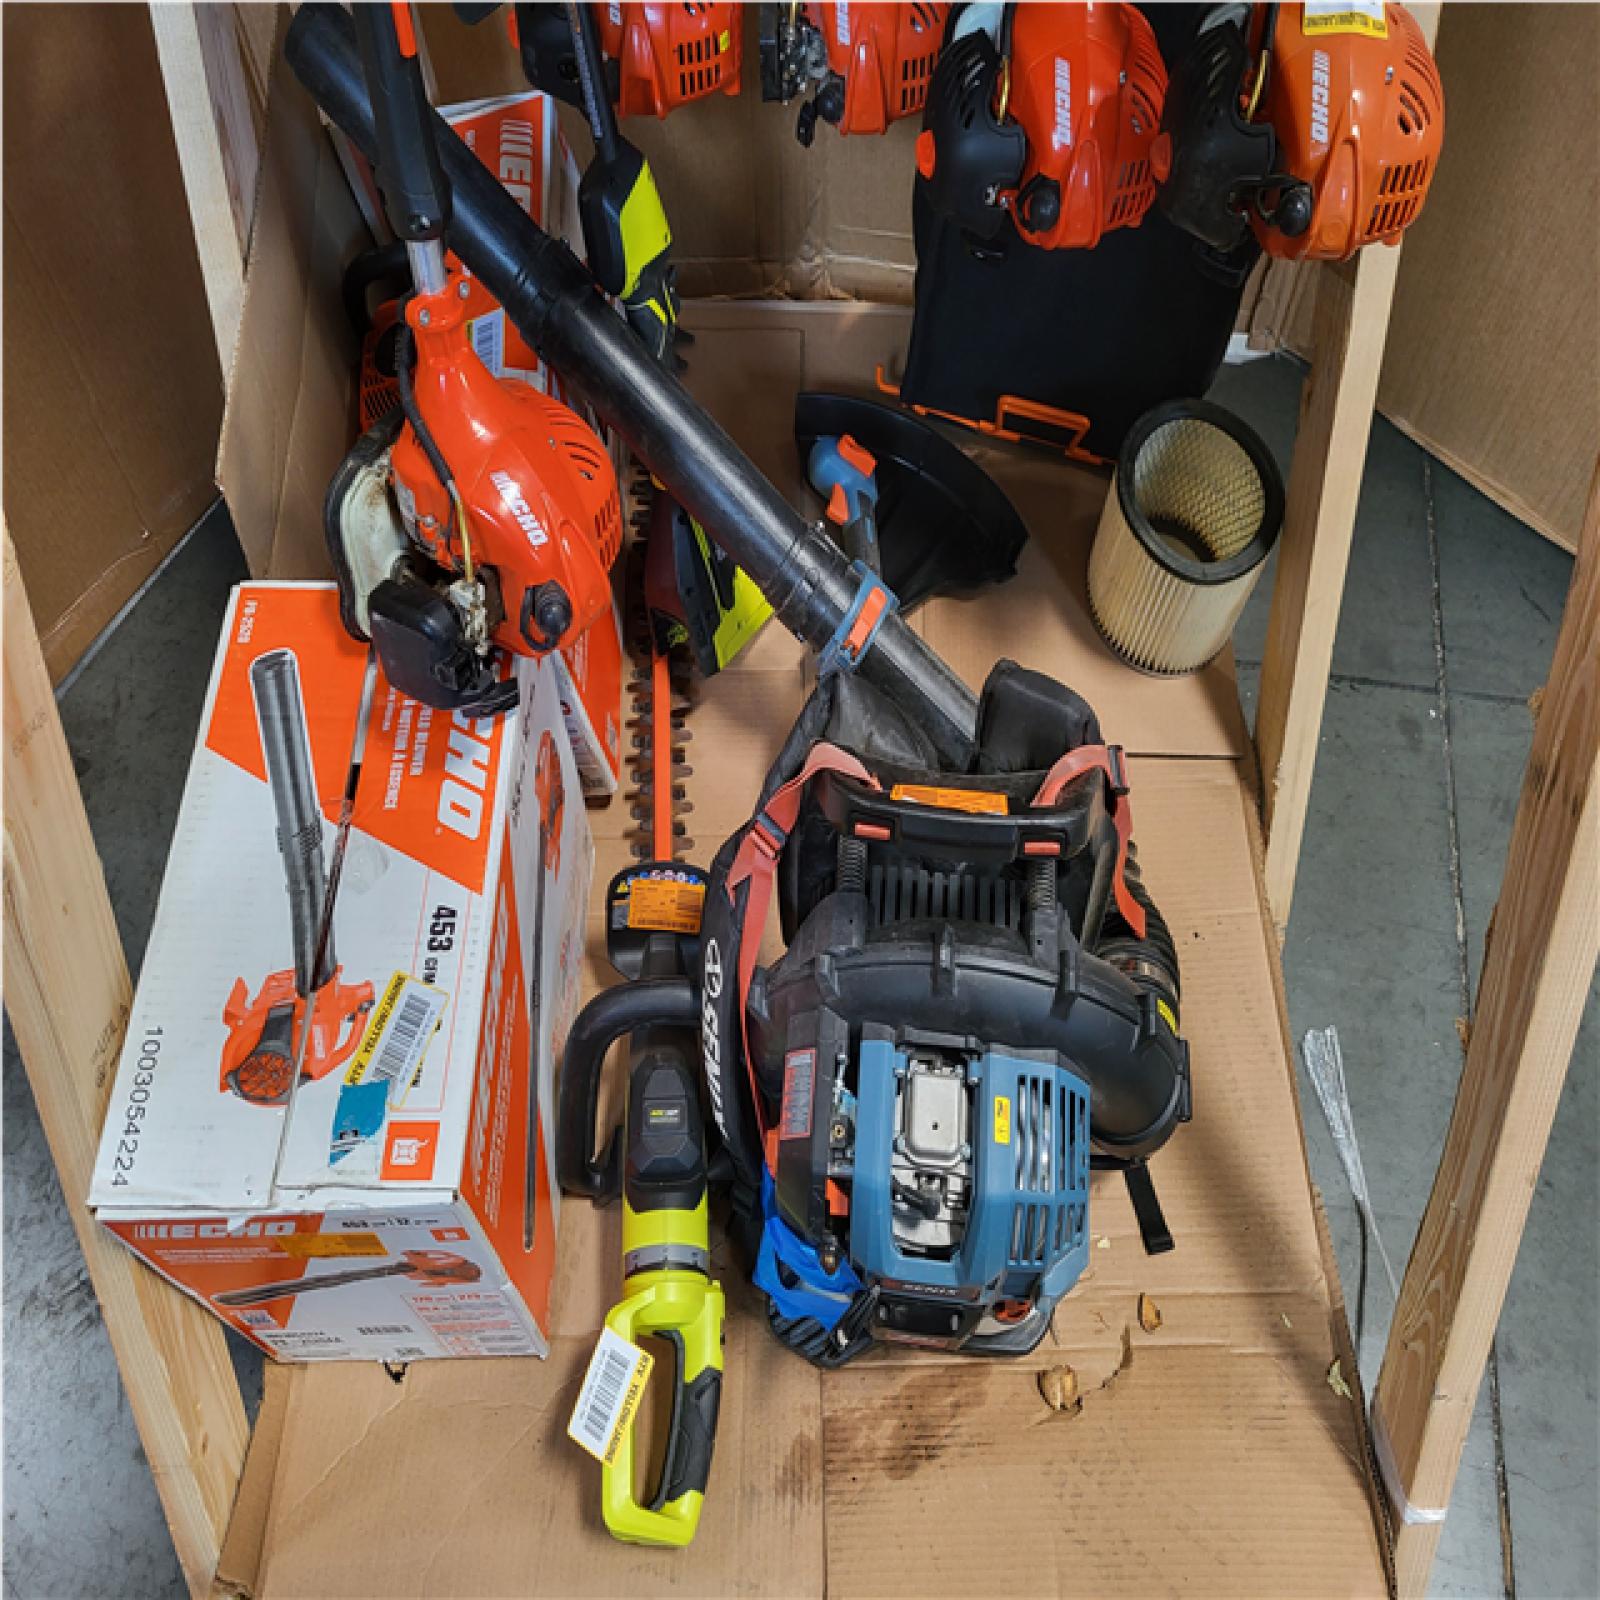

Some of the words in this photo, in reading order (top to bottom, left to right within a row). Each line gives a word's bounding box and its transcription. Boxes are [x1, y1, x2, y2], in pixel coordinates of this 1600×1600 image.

[1054, 57, 1071, 149] ECHO
[1311, 50, 1330, 143] ECHO
[427, 904, 458, 952] 453
[111, 1026, 164, 1188] 1003054224
